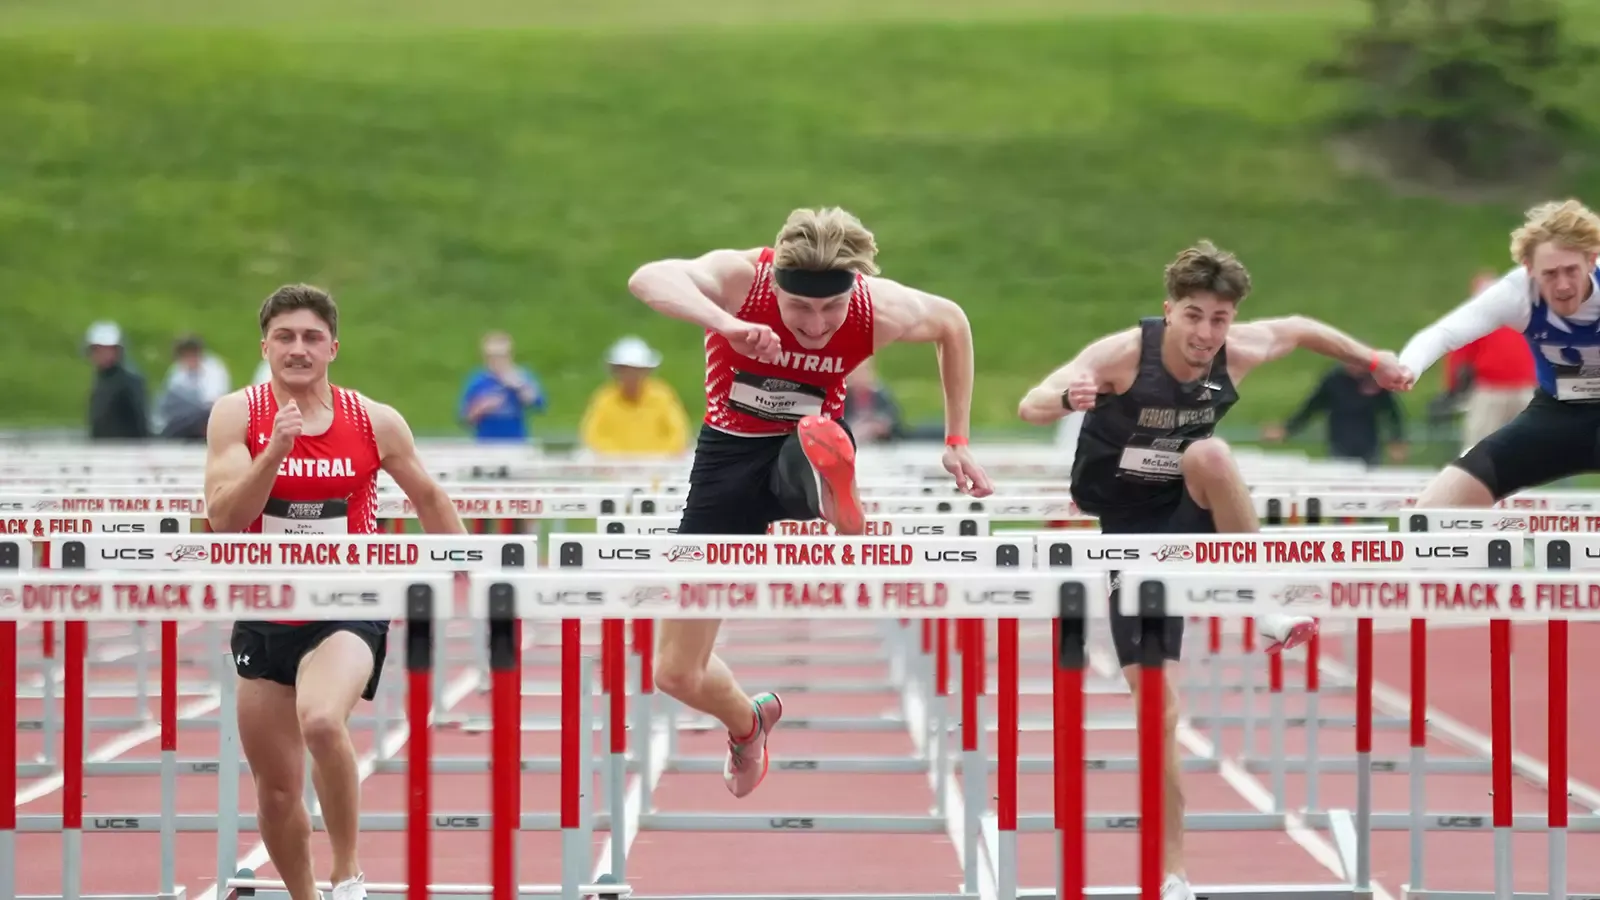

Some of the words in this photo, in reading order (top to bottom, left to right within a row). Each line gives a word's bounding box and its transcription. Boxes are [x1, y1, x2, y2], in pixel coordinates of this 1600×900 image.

[753, 351, 845, 373] NTRAL
[755, 395, 797, 408] Huyser
[277, 457, 356, 477] ENTRAL
[1142, 458, 1179, 469] McLain
[0, 502, 23, 510] CS
[62, 499, 104, 513] DUTCH
[109, 499, 150, 513] TRACK
[169, 499, 205, 513] FIELD
[451, 499, 491, 514] RACK
[508, 499, 544, 514] FIELD
[0, 518, 28, 534] ACK
[33, 519, 44, 537] &
[50, 518, 93, 534] FIELD
[102, 523, 145, 533] UCS
[780, 521, 829, 536] TRACK
[864, 521, 893, 536] ELD
[902, 525, 945, 535] UCS
[1440, 520, 1484, 530] UCS
[1529, 515, 1579, 533] DUTCH
[101, 548, 154, 560] UCS
[211, 543, 272, 564] DUTCH
[279, 543, 341, 565] TRACK
[346, 543, 360, 565] &
[367, 543, 419, 565] FIELD
[430, 549, 483, 561] UCS
[598, 548, 651, 560] UCS
[706, 543, 767, 564] DUTCH
[774, 543, 836, 565] TRACK
[841, 543, 855, 565] &
[861, 543, 913, 565] FIELD
[925, 550, 977, 562] UCS
[1087, 548, 1140, 560] UCS
[1195, 541, 1256, 563] DUTCH
[1263, 541, 1326, 562] TRACK
[1331, 541, 1345, 562] &
[1352, 540, 1404, 562] FIELD
[1415, 546, 1469, 558] UCS
[22, 584, 103, 610] DUTCH
[112, 584, 192, 610] TRACK
[203, 584, 217, 610] &
[228, 584, 295, 610] FIELD
[311, 592, 380, 606] UCS
[536, 591, 606, 605] UCS
[679, 583, 758, 609] DUTCH
[768, 582, 847, 609] TRACK
[856, 583, 870, 609] &
[882, 583, 948, 609] FIELD
[964, 590, 1032, 605] UCS
[1187, 589, 1256, 603] UCS
[1331, 582, 1409, 609] DUTCH
[1420, 583, 1500, 609] TRACK
[1509, 583, 1525, 609] &
[1536, 584, 1600, 610] FIELD
[95, 818, 139, 829] UCS
[435, 817, 480, 828] UCS
[770, 818, 814, 829] UCS
[1437, 817, 1483, 827] UCS
